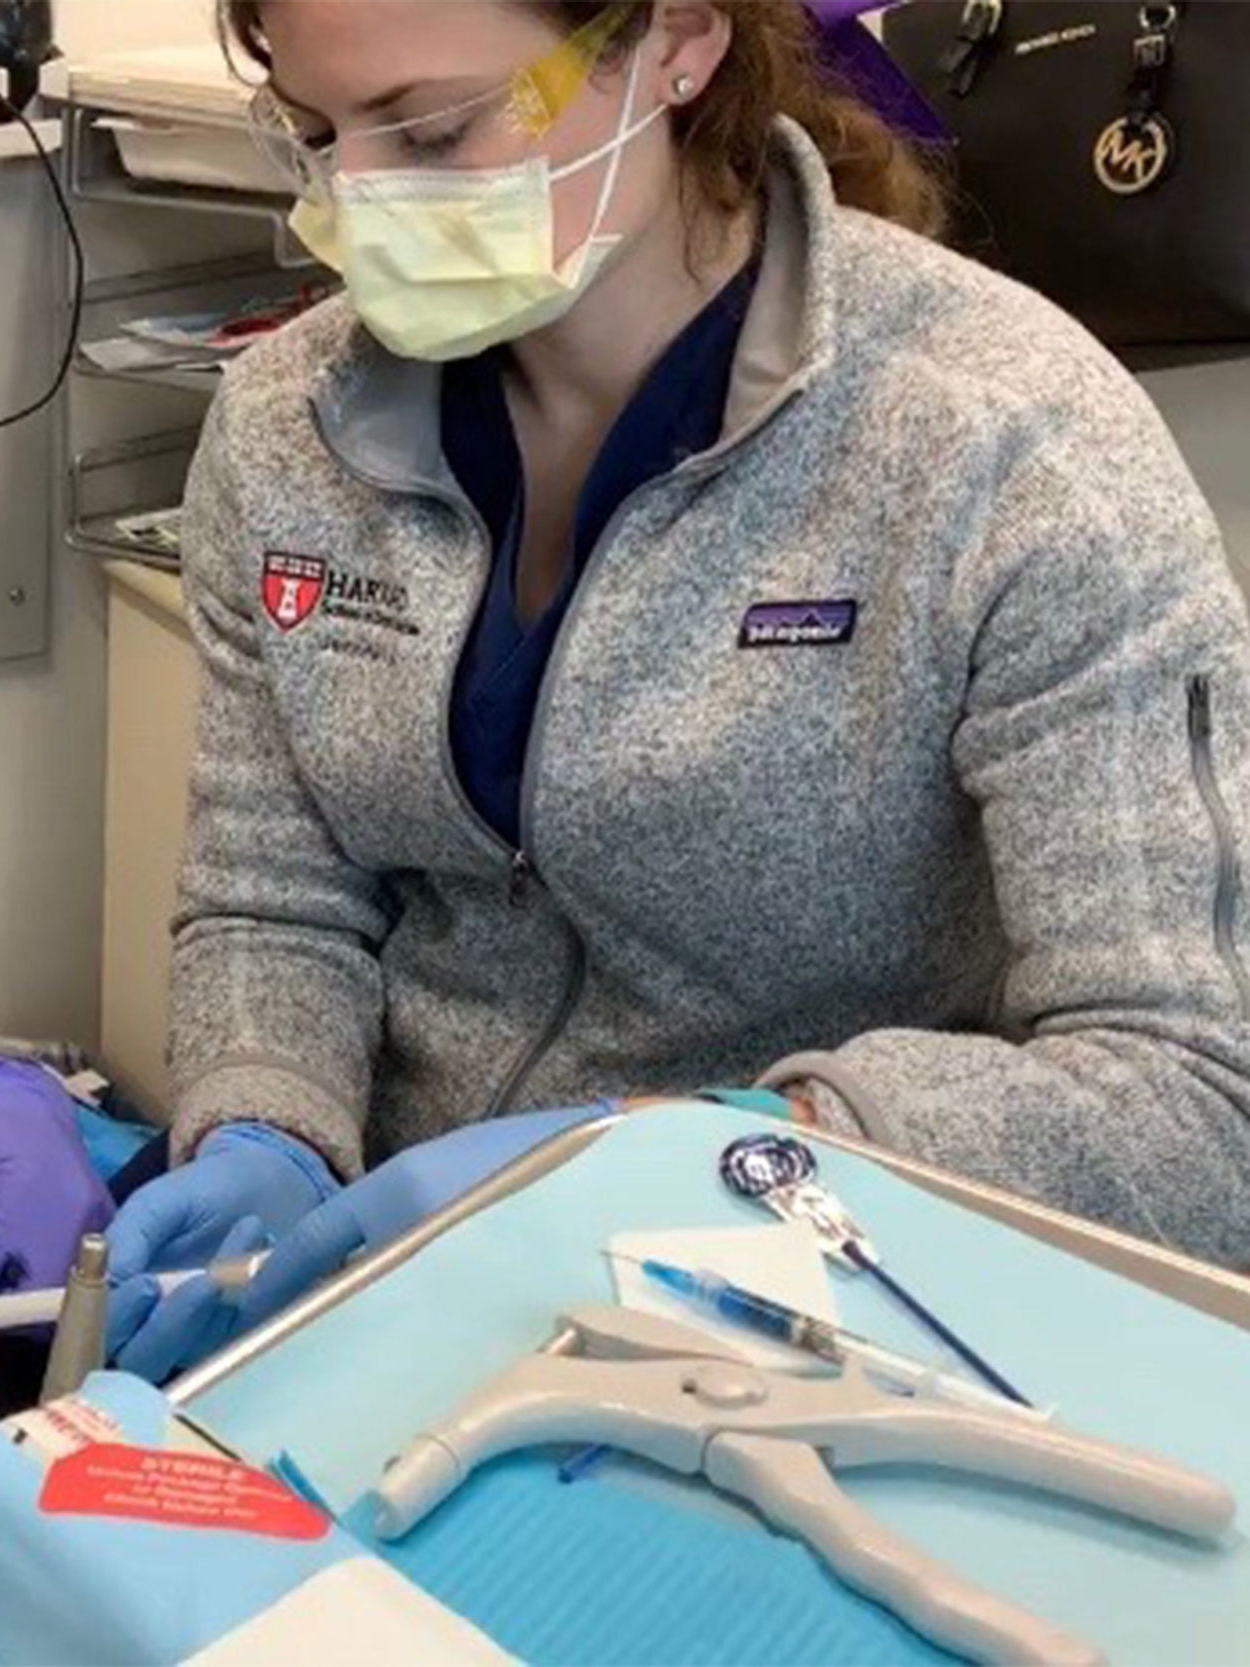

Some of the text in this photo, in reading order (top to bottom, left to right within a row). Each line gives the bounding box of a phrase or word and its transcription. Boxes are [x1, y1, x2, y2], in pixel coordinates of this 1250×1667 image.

[1096, 126, 1158, 181] MK
[326, 570, 408, 611] HARV
[141, 1457, 244, 1480] STERILE
